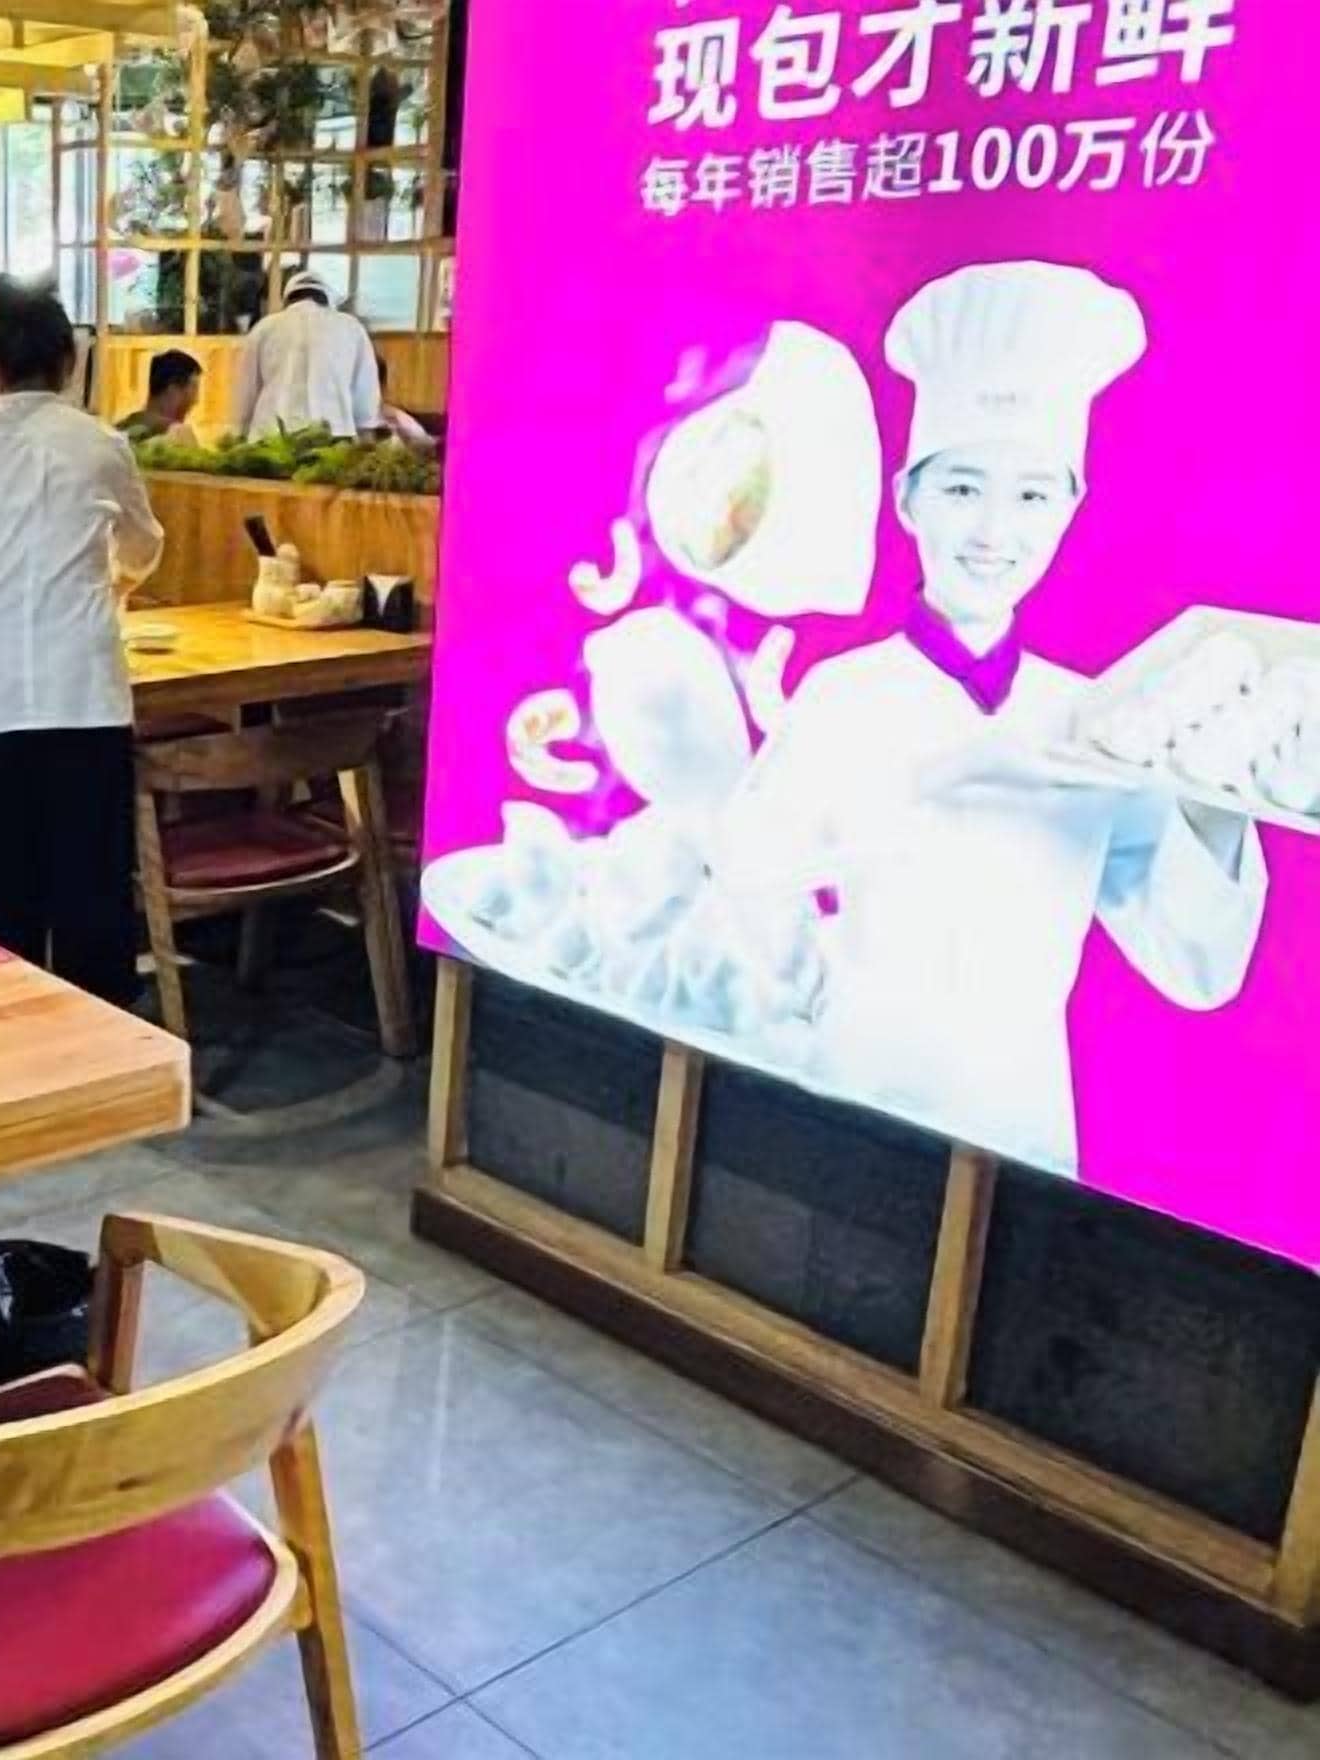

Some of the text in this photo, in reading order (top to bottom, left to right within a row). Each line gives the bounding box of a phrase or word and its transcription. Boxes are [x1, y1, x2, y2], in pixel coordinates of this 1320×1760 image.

[647, 0, 1236, 131] 现包才新鲜
[639, 109, 1216, 217] 每年销售超100万份
